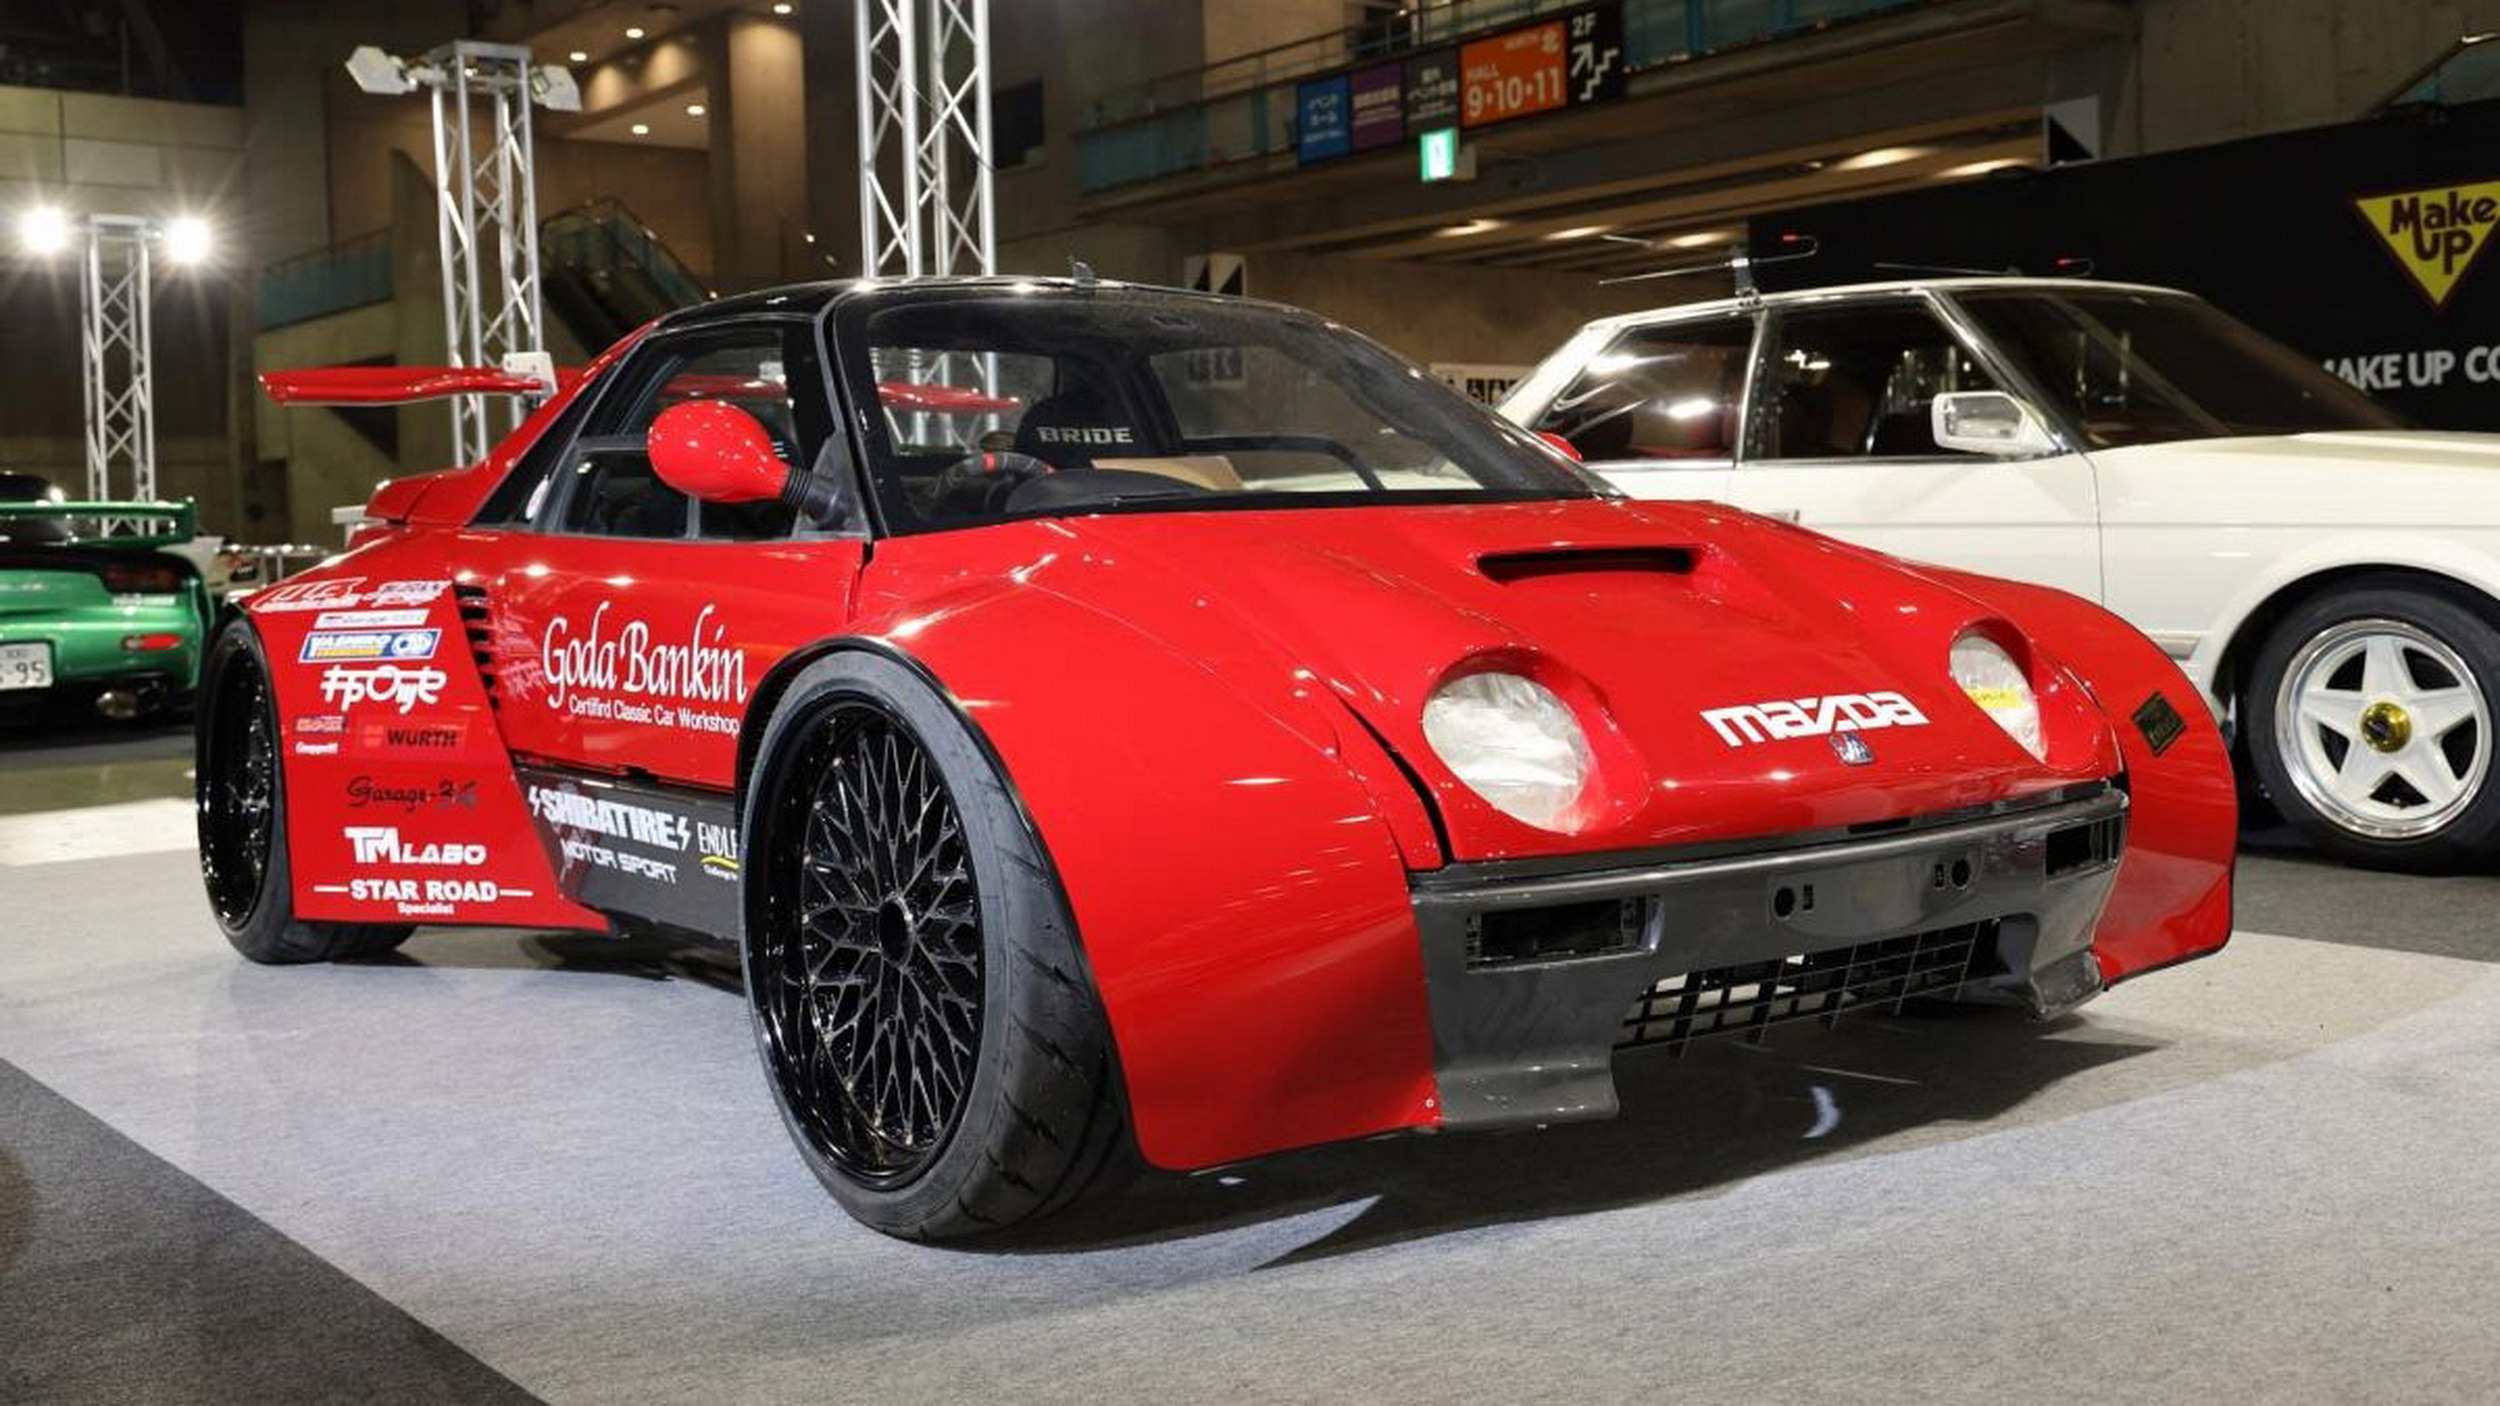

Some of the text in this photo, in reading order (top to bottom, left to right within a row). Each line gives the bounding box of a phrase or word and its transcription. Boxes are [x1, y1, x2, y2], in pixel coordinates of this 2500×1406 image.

[1572, 13, 1597, 37] 2F
[2390, 191, 2497, 235] Make
[2408, 351, 2455, 386] UP
[1036, 427, 1134, 444] BRIDE
[543, 601, 617, 708] Goda
[619, 604, 748, 704] Bankin
[613, 698, 652, 724] Classic
[654, 704, 675, 727] Car
[678, 707, 740, 740] Workshop
[540, 788, 680, 851] SHIBATIRE
[560, 837, 617, 870] MOTOR
[616, 852, 677, 884] SPORT
[350, 879, 498, 902] STAR ROAD
